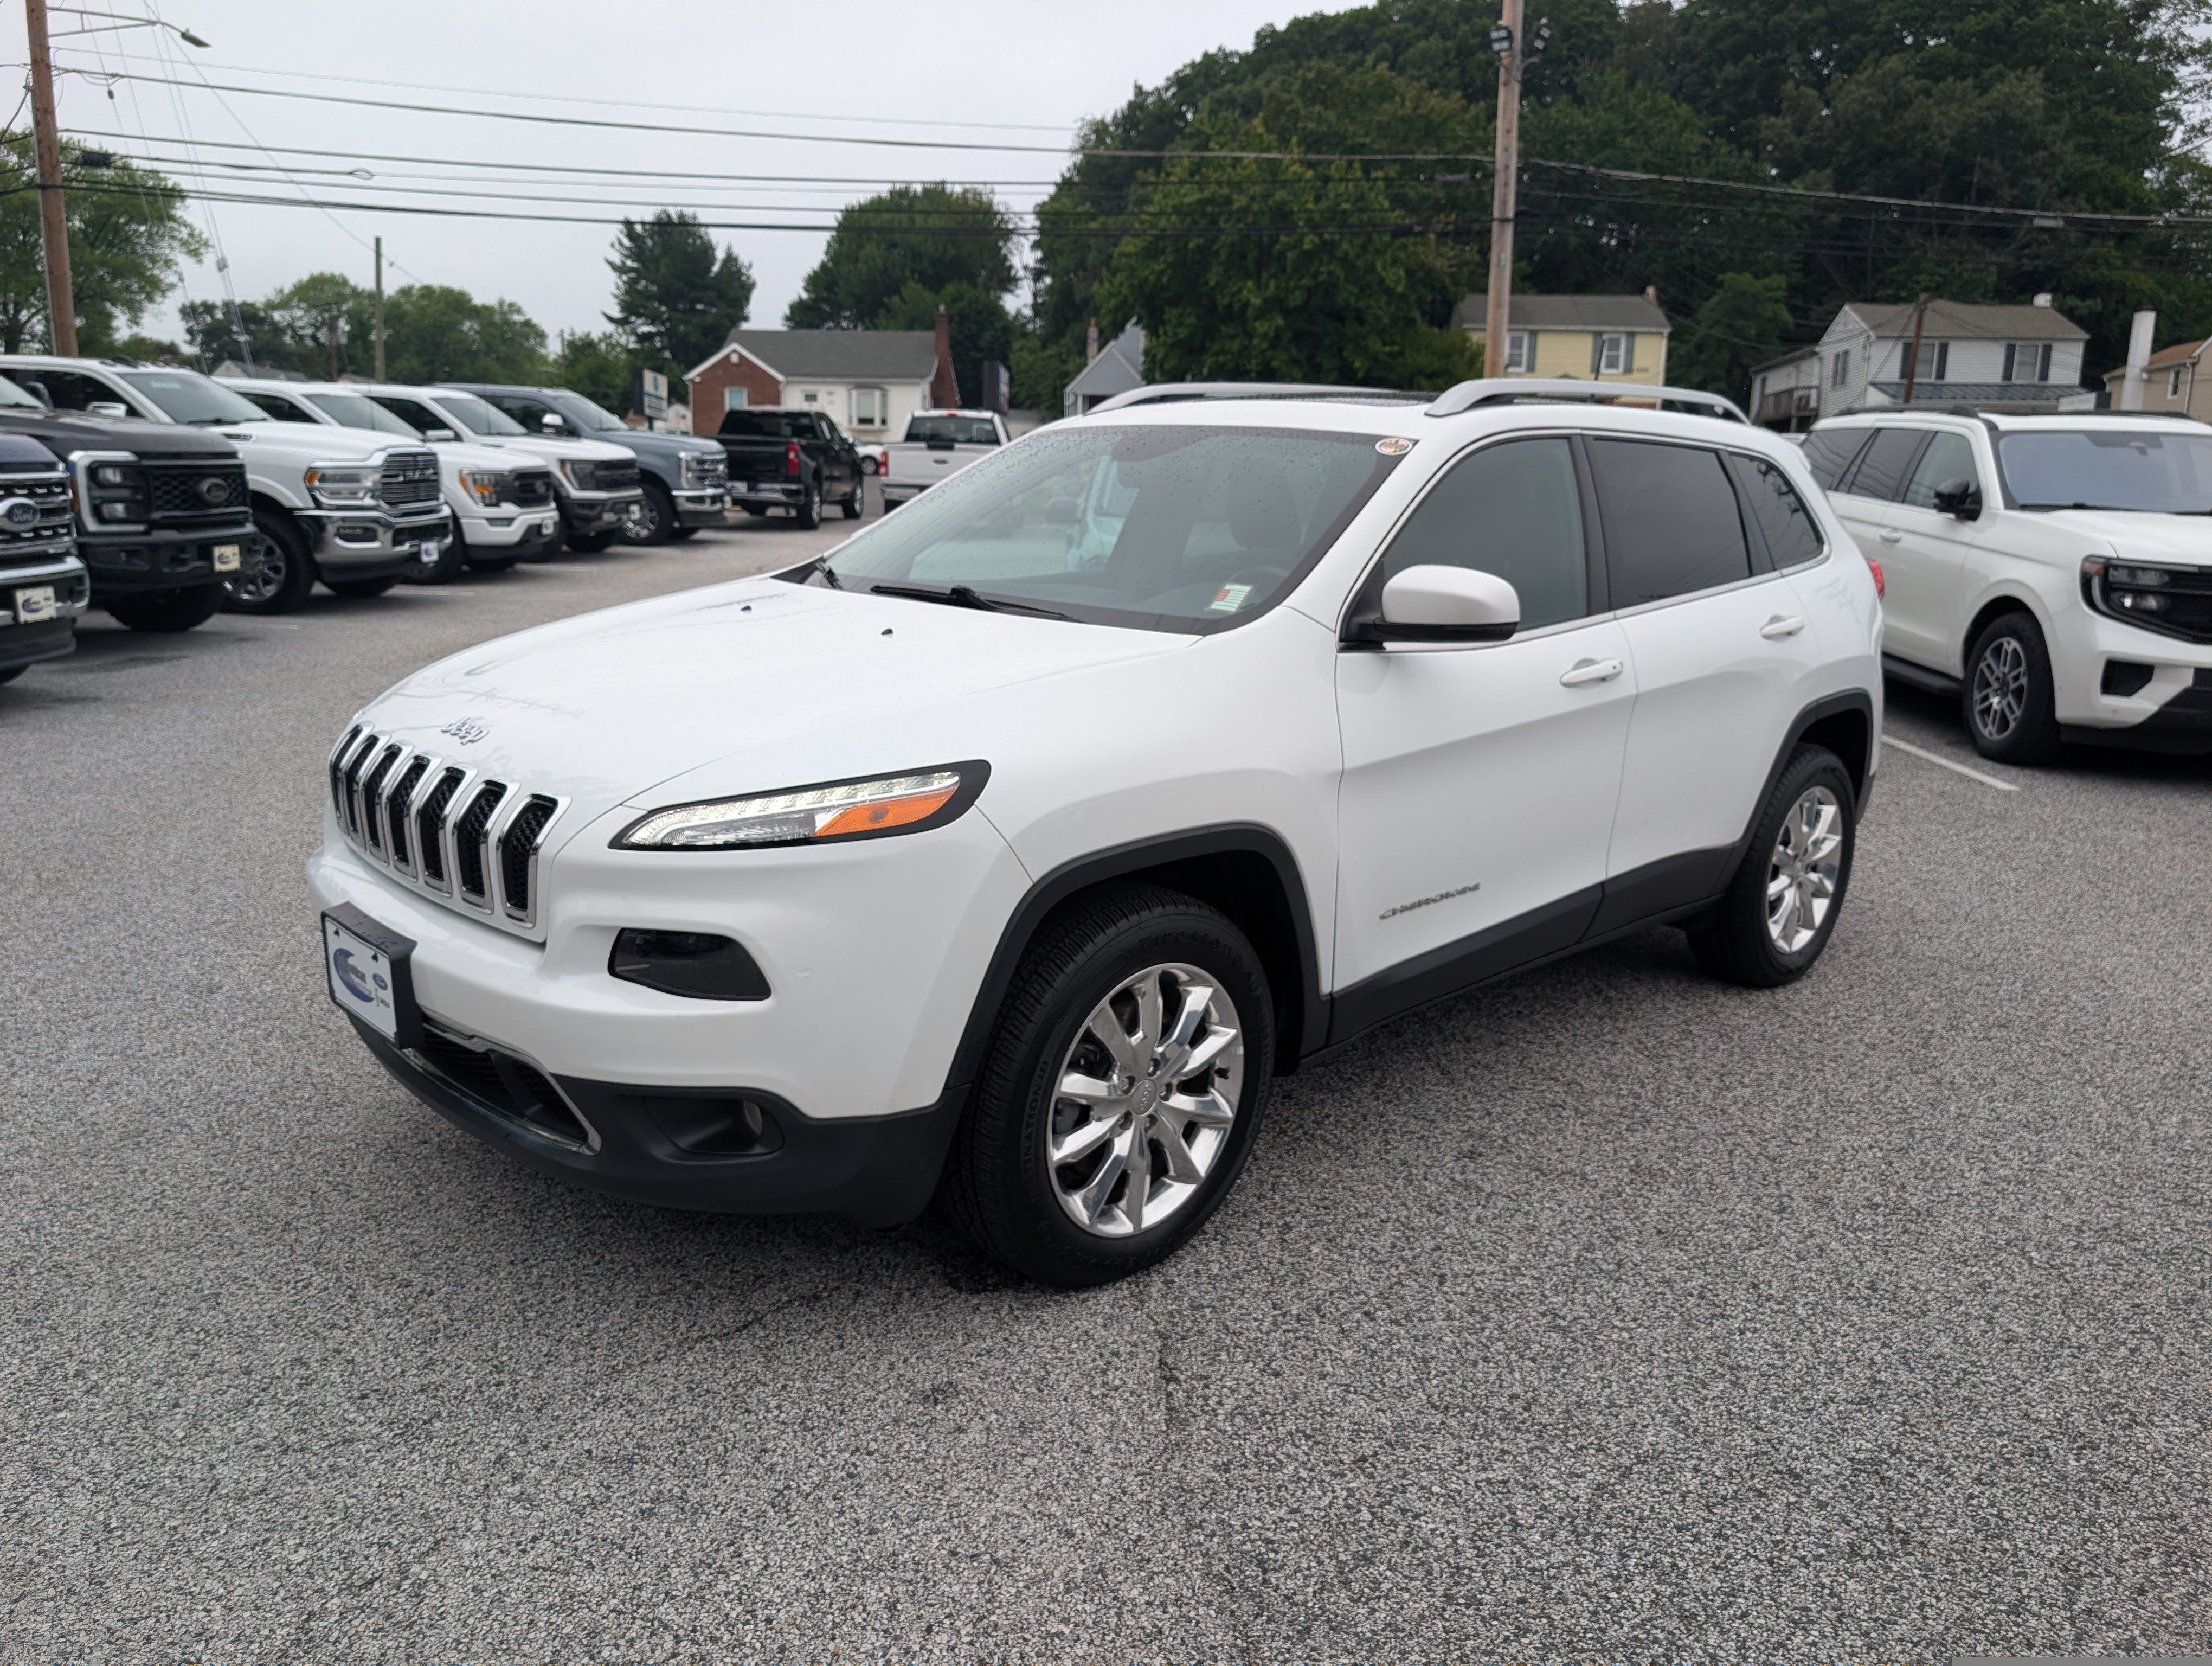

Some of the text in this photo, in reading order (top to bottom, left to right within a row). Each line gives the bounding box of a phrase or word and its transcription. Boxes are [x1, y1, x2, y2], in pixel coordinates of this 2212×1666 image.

[12, 507, 33, 522] Ford
[441, 716, 490, 746] Jeep
[1379, 882, 1482, 920] CHEROKEE
